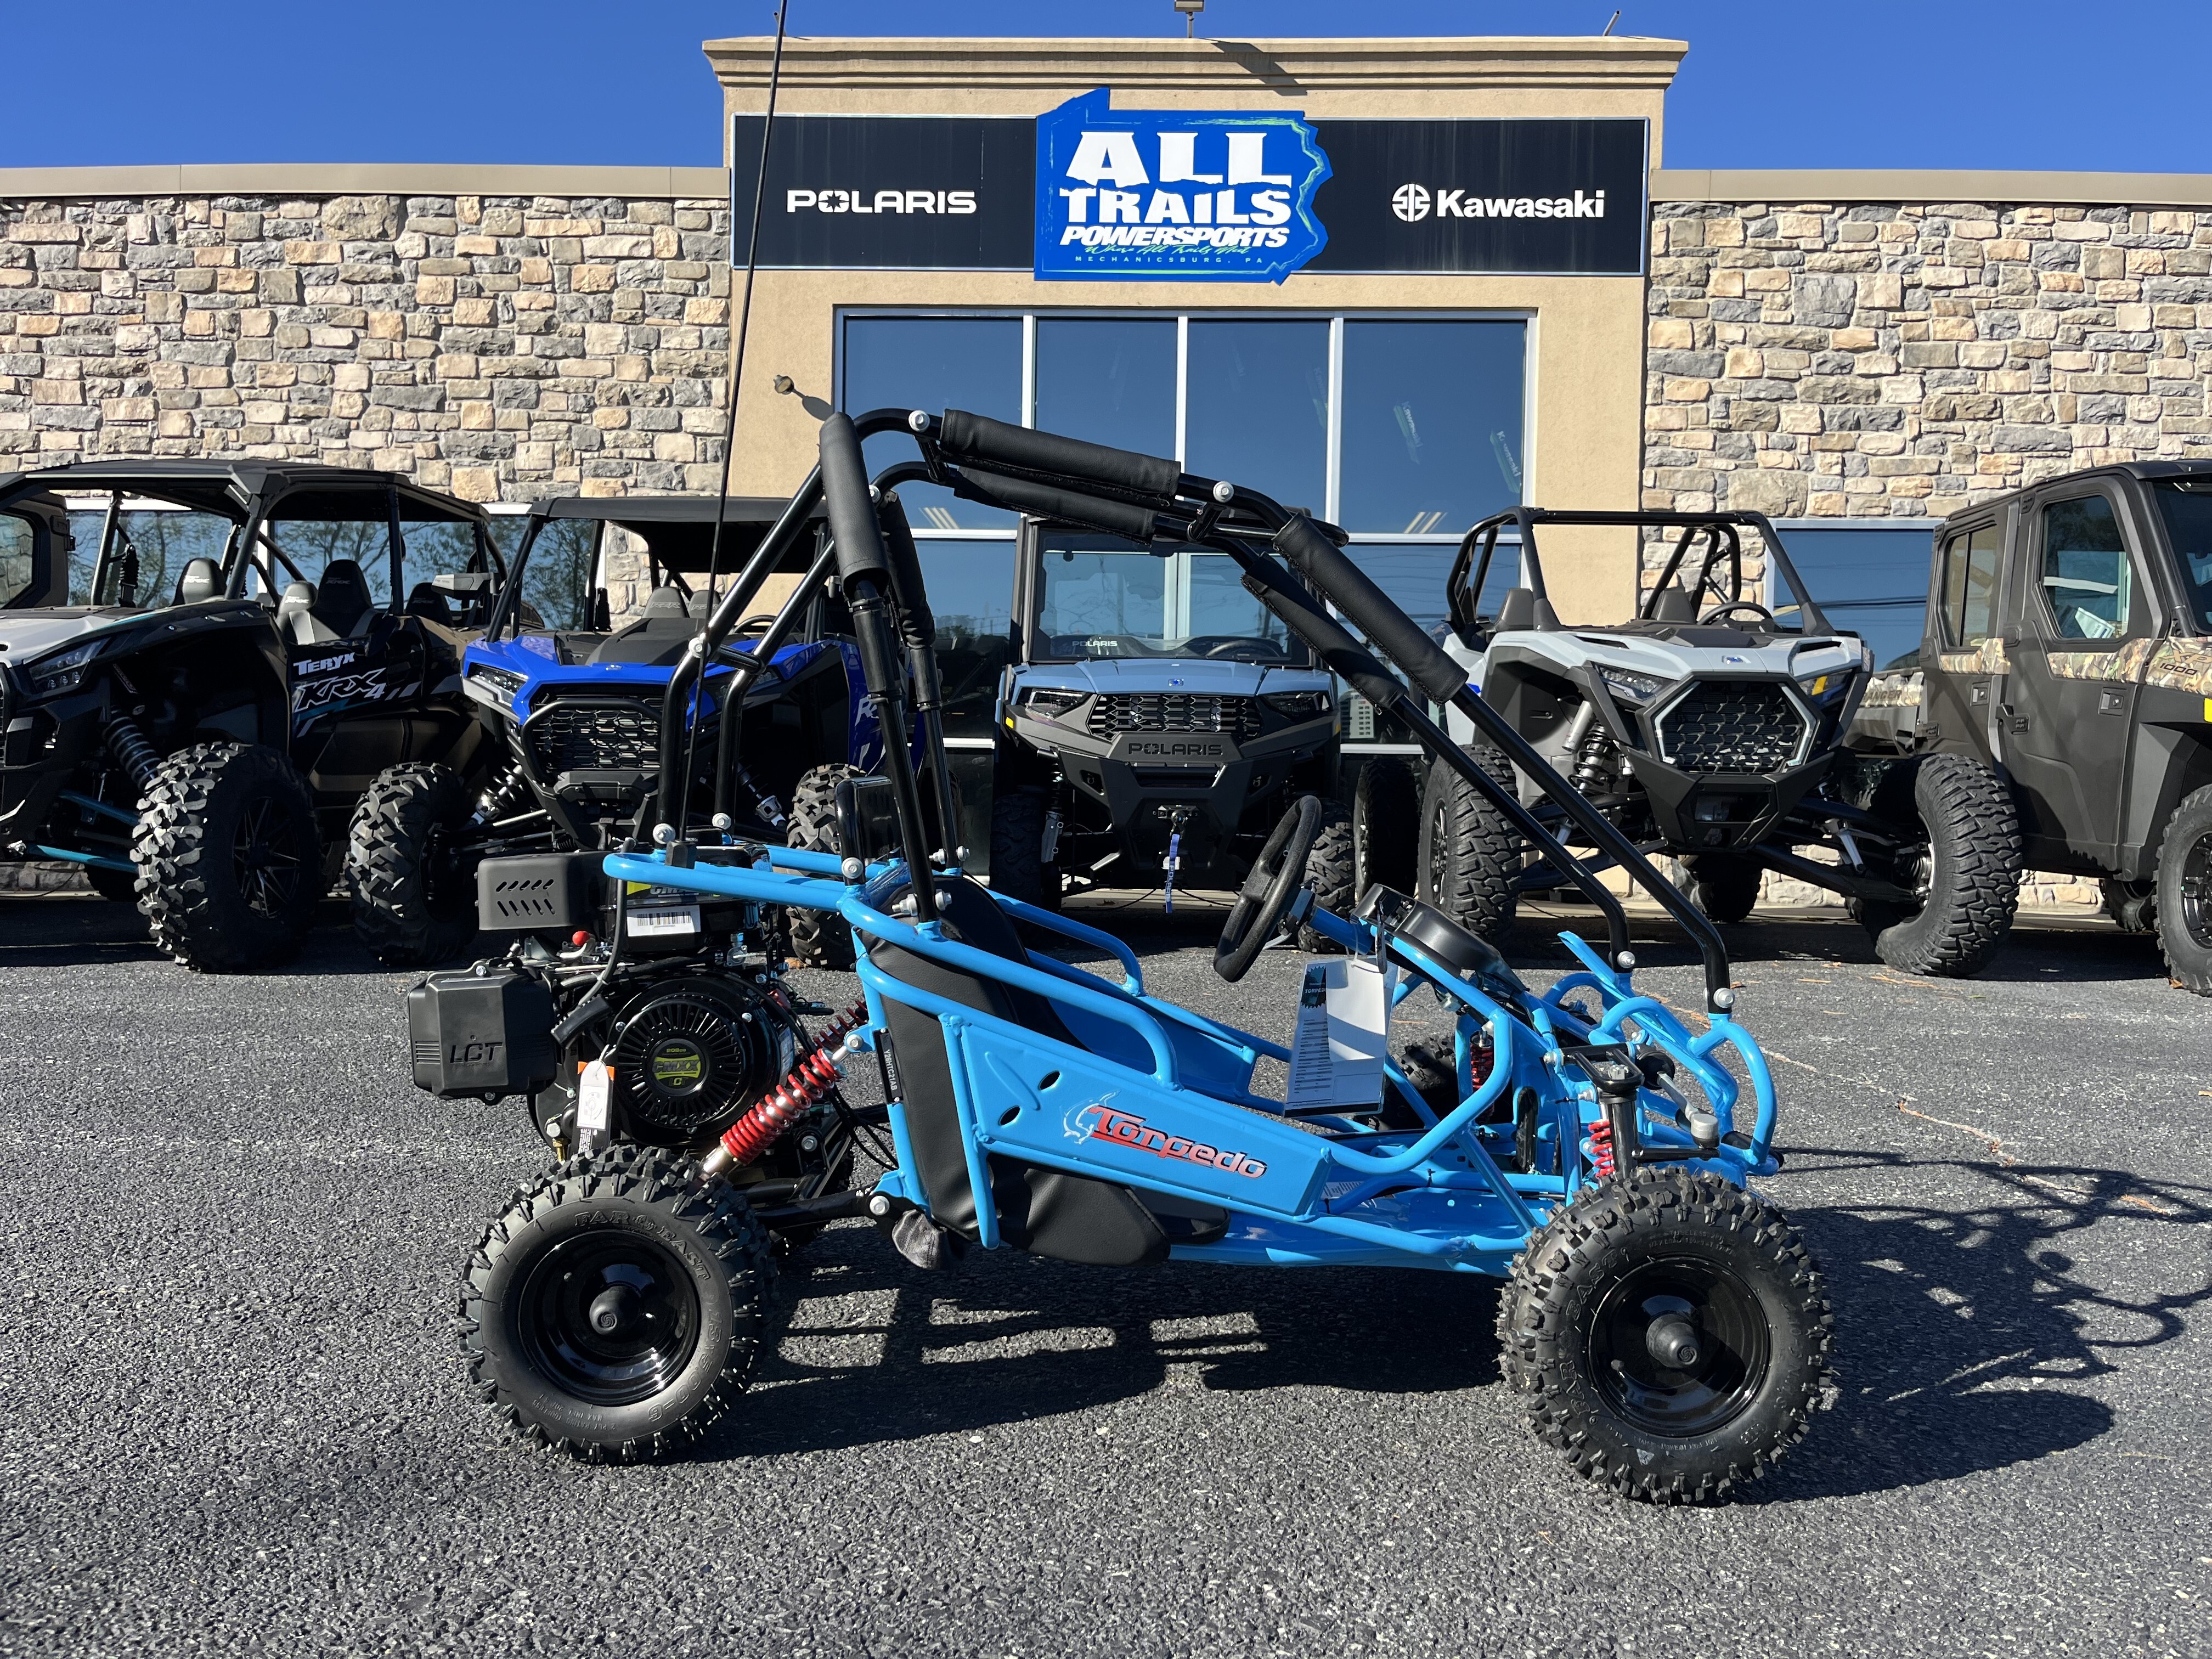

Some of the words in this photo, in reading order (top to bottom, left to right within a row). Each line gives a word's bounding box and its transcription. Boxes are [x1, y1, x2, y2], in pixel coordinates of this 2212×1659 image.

[1065, 131, 1292, 188] ALL
[787, 189, 977, 214] POLARIS
[1059, 188, 1291, 225] TRAILS
[1436, 189, 1605, 218] Kawasaki
[1059, 226, 1290, 248] POWERSPORTS
[1084, 245, 1135, 255] Where
[1137, 245, 1166, 255] All
[1170, 244, 1211, 255] Trails
[1211, 245, 1252, 255] Meet
[2158, 650, 2212, 664] XP
[2160, 663, 2198, 675] 1000
[1863, 690, 1902, 702] ANGER
[1128, 743, 1223, 756] POLARIS
[1165, 865, 1174, 902] POLARIS
[449, 1042, 503, 1063] LCT
[1088, 1105, 1268, 1179] Torpedo
[574, 1210, 630, 1227] FAR
[656, 1226, 711, 1280] EAST
[1565, 1249, 1618, 1321] EAST
[1560, 1360, 1590, 1416] FAR
